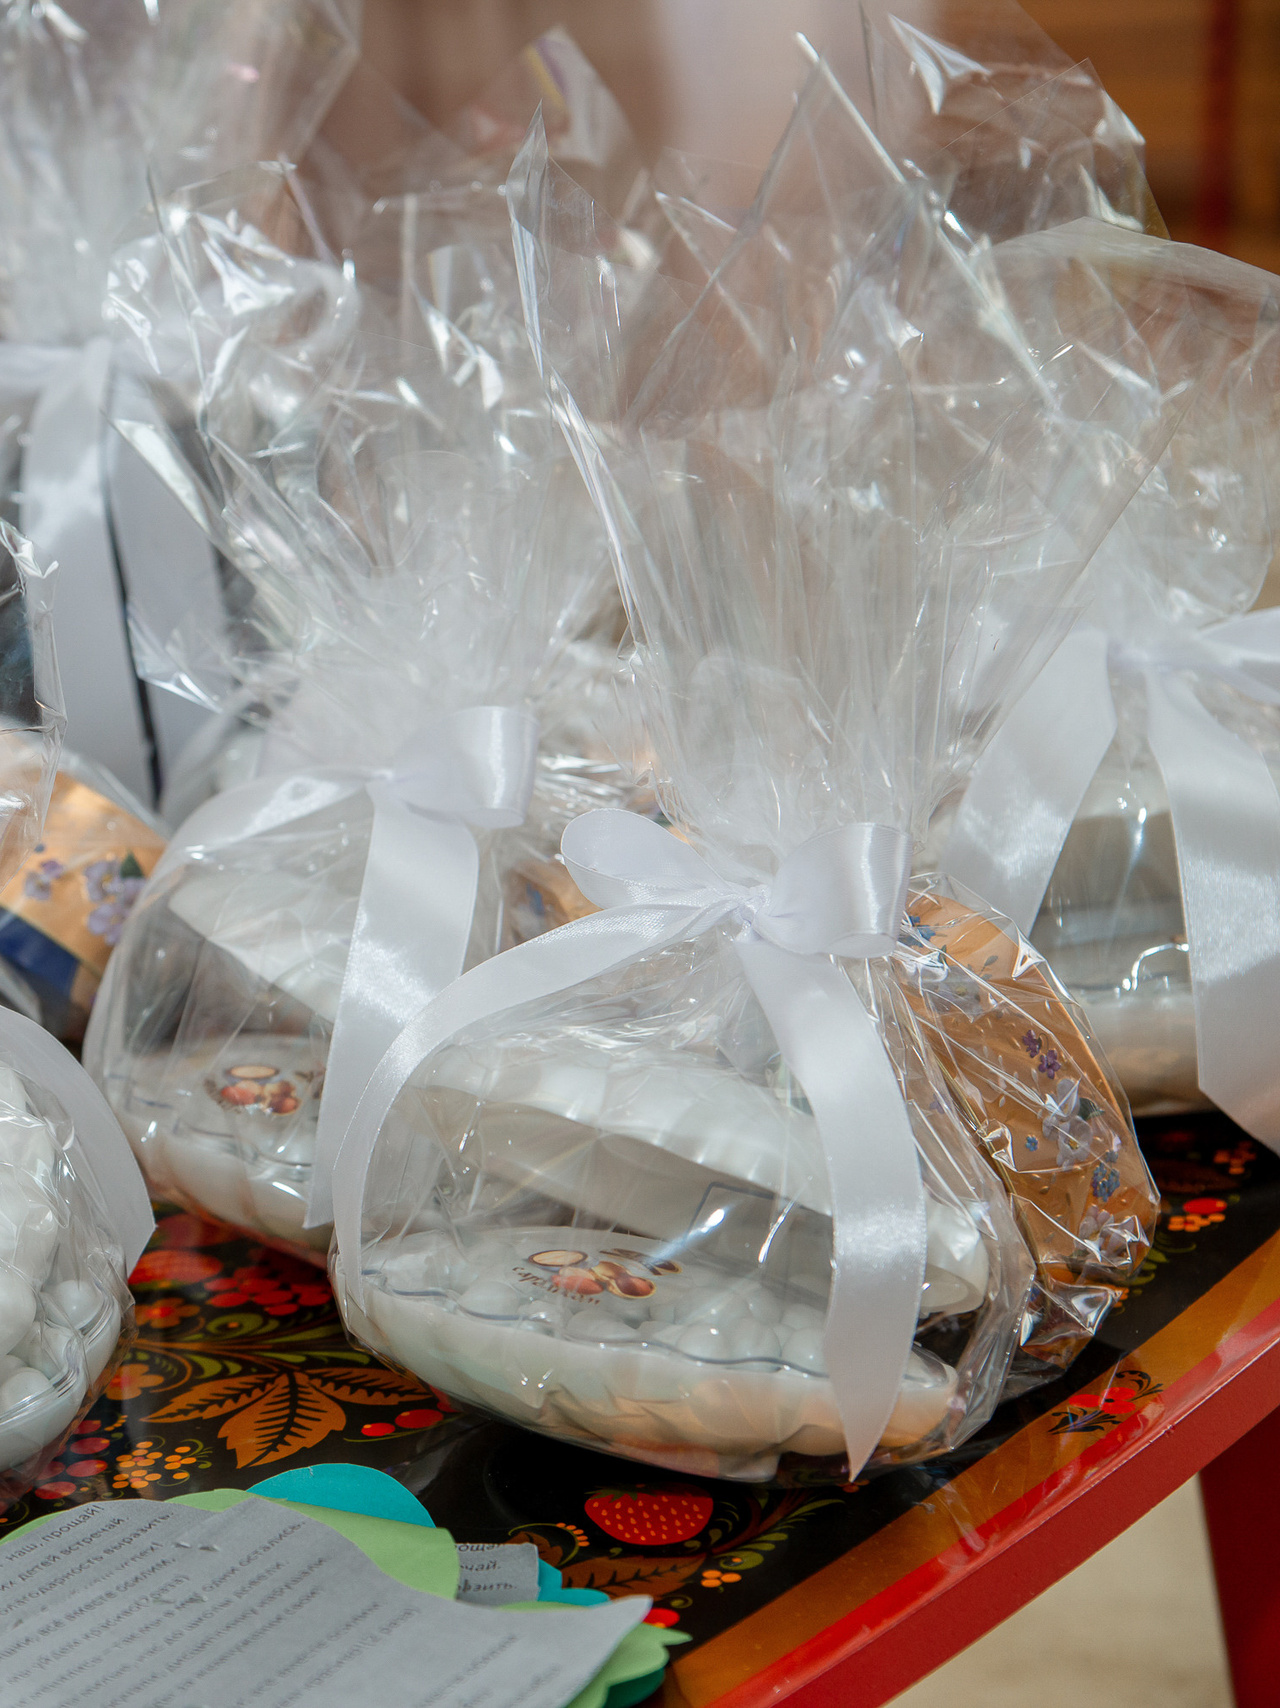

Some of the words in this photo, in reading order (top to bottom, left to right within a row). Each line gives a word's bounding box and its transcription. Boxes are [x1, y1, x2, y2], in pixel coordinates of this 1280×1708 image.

[4, 1539, 44, 1562] наш,
[39, 1502, 106, 1543] прощай!
[14, 1552, 62, 1582] детей
[58, 1513, 131, 1556] встречай.
[459, 1559, 501, 1572] чай.
[61, 1588, 120, 1622] вместе
[181, 1596, 234, 1632] школы
